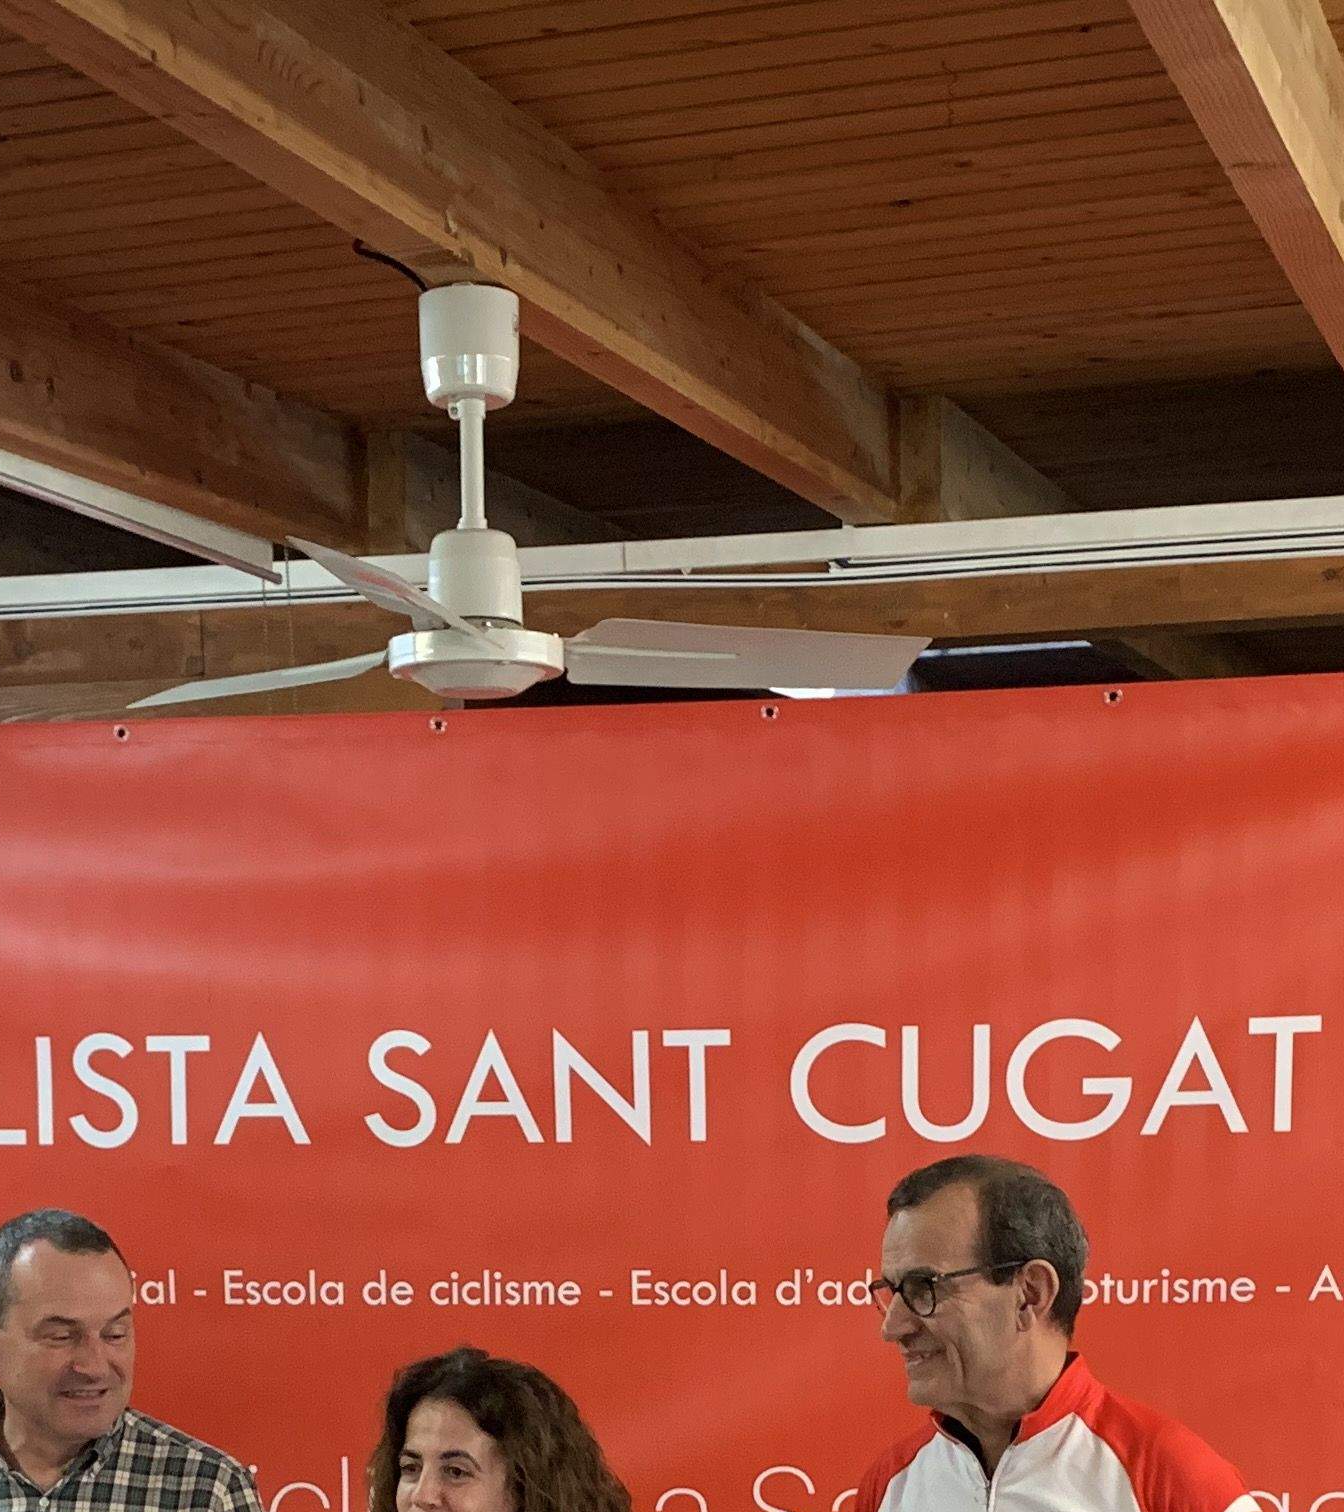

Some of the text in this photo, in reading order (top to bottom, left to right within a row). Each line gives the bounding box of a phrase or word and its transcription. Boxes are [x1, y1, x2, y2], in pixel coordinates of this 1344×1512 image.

[364, 1028, 731, 1148] SANT
[789, 1014, 1323, 1144] CUGAT
[223, 1269, 345, 1306] Escola
[362, 1269, 414, 1306] de
[429, 1269, 582, 1306] ciclisme
[631, 1268, 757, 1306] Escola
[1082, 1267, 1257, 1306] oturisme
